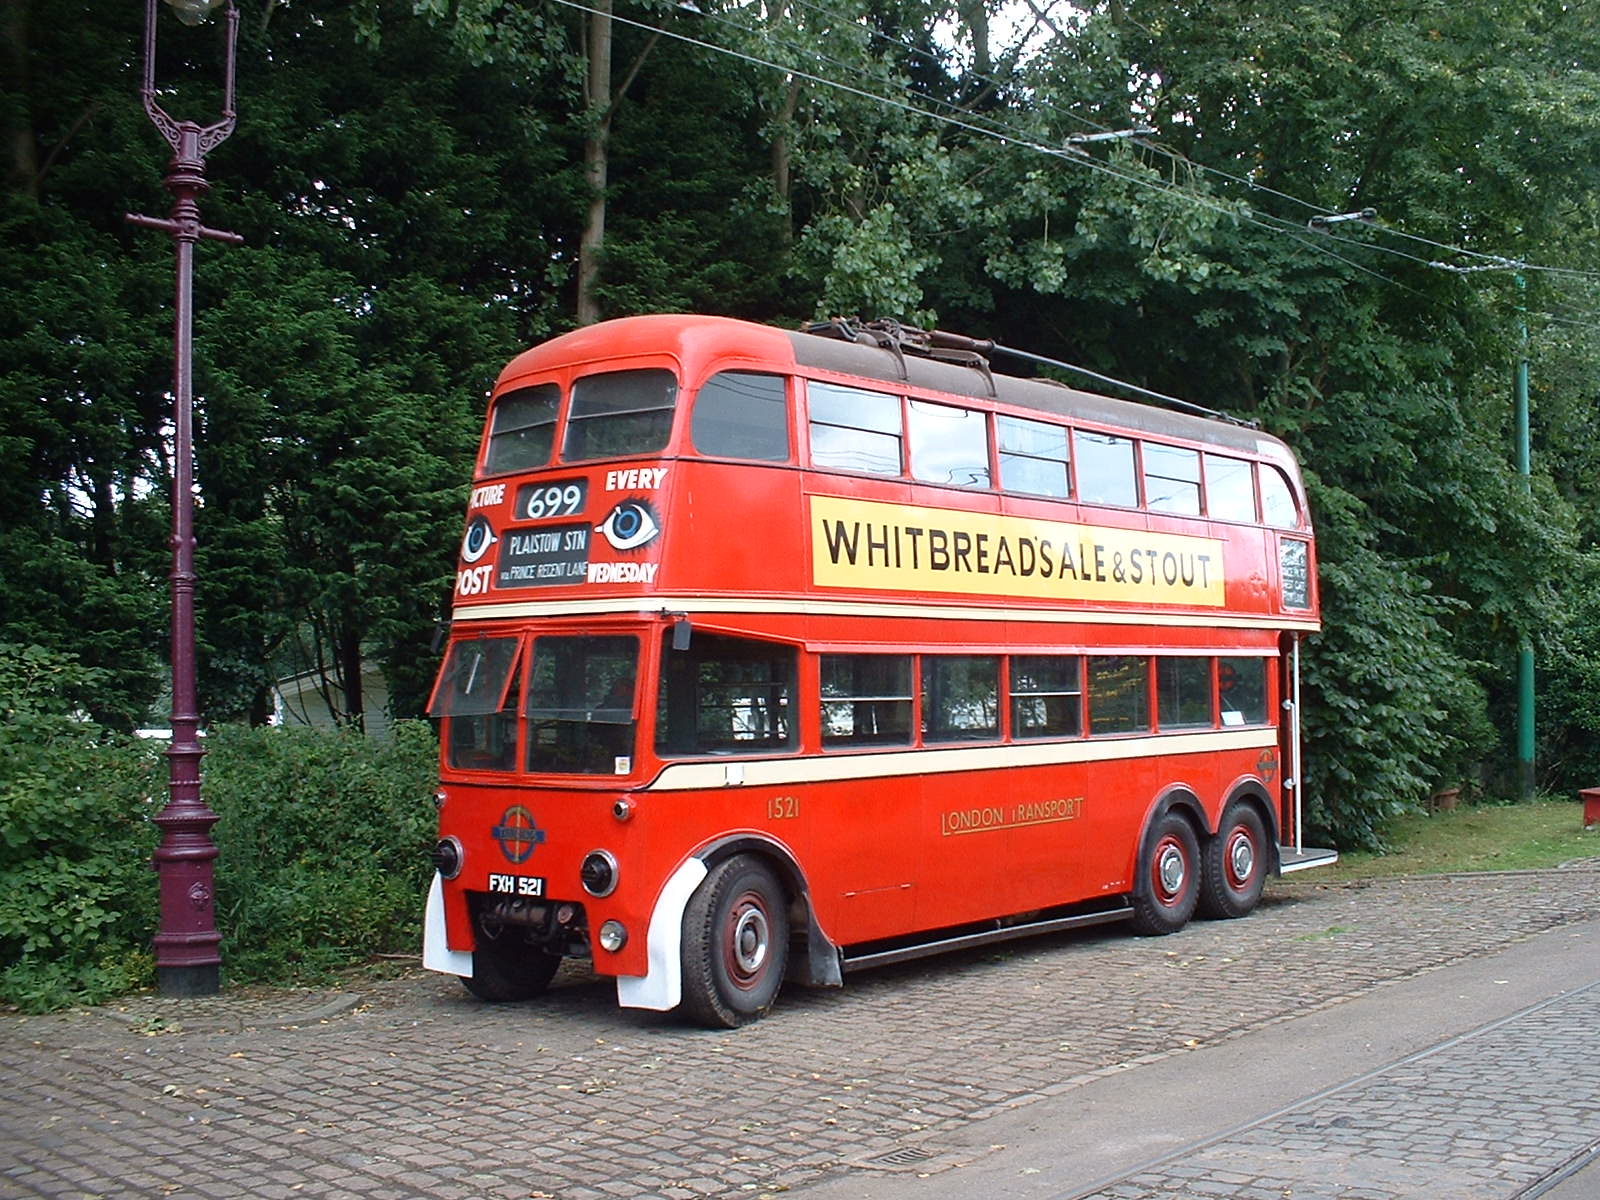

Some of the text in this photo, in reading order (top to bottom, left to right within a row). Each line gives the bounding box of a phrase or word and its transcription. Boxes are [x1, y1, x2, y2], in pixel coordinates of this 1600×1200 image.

[605, 468, 668, 491] EVERY
[527, 486, 581, 518] 699
[510, 530, 586, 556] PLAISTOW STN
[823, 518, 1211, 589] WHITBREAD'S ALE & STOUT
[510, 564, 536, 580] PRINCE
[536, 562, 566, 578] REGENT
[566, 562, 588, 576] LANE
[587, 563, 658, 584] WEDNESDAY
[768, 797, 799, 819] 1521
[942, 798, 1084, 836] LONDON TRANSPORT
[489, 874, 542, 896] FXH 521
